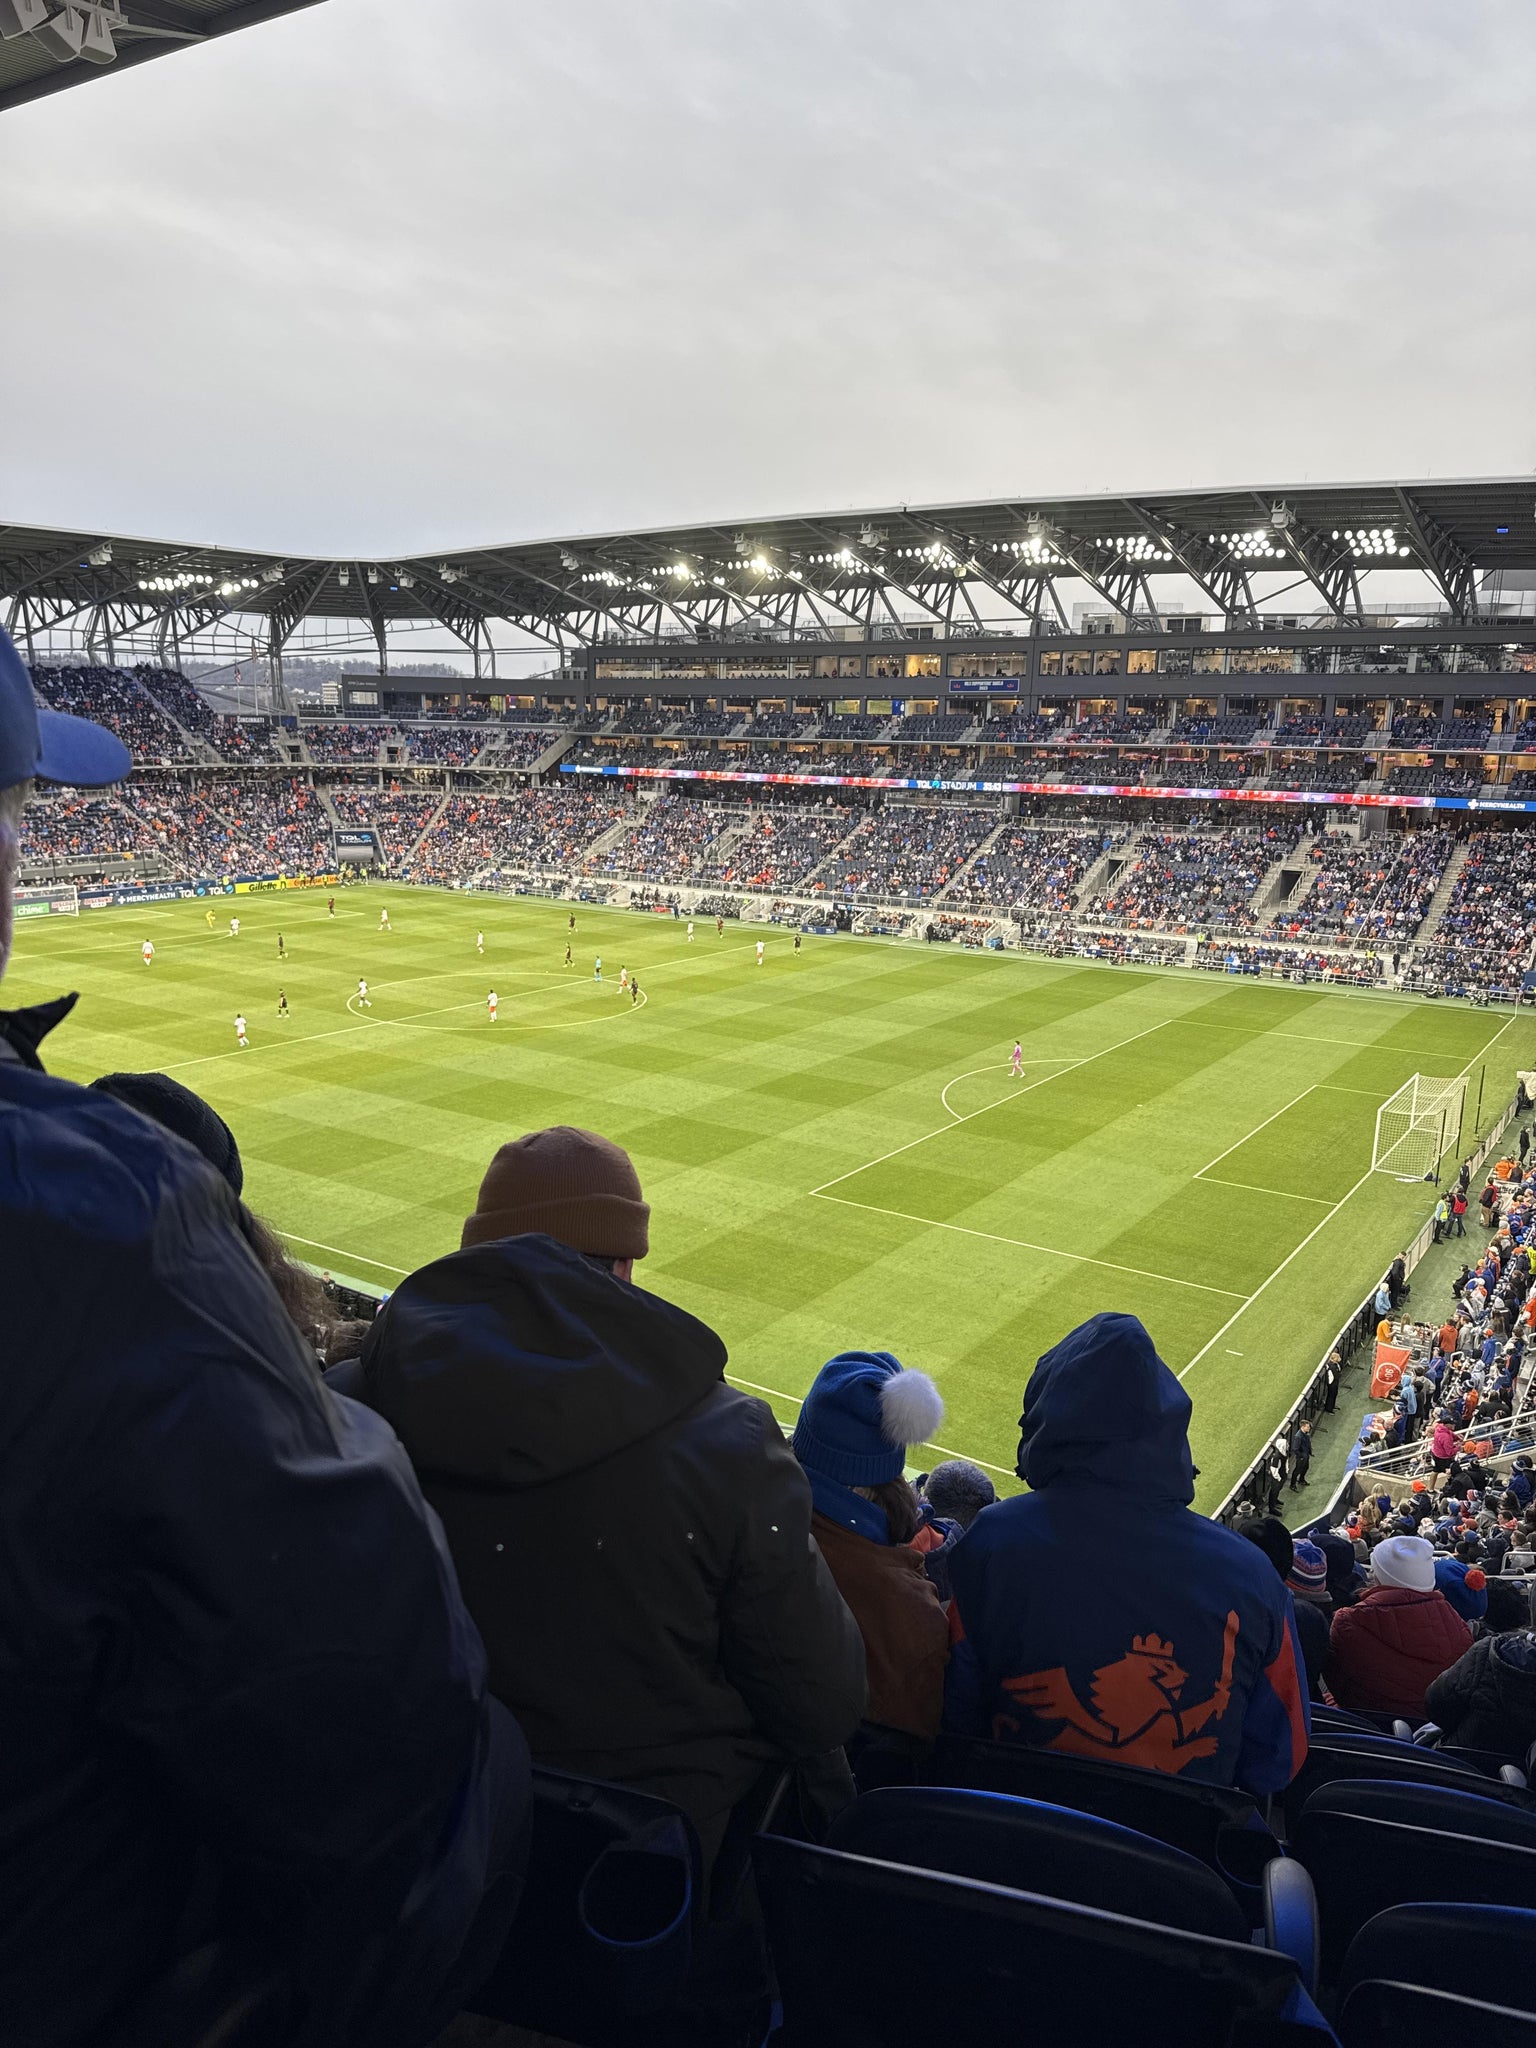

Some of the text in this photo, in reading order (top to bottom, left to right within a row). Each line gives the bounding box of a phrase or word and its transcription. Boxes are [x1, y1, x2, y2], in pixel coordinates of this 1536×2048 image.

[941, 781, 976, 791] STADIUM
[209, 886, 226, 895] TQL
[248, 882, 277, 892] Gillette
[126, 892, 175, 902] MERCYHEALTH
[179, 888, 197, 899] TQL
